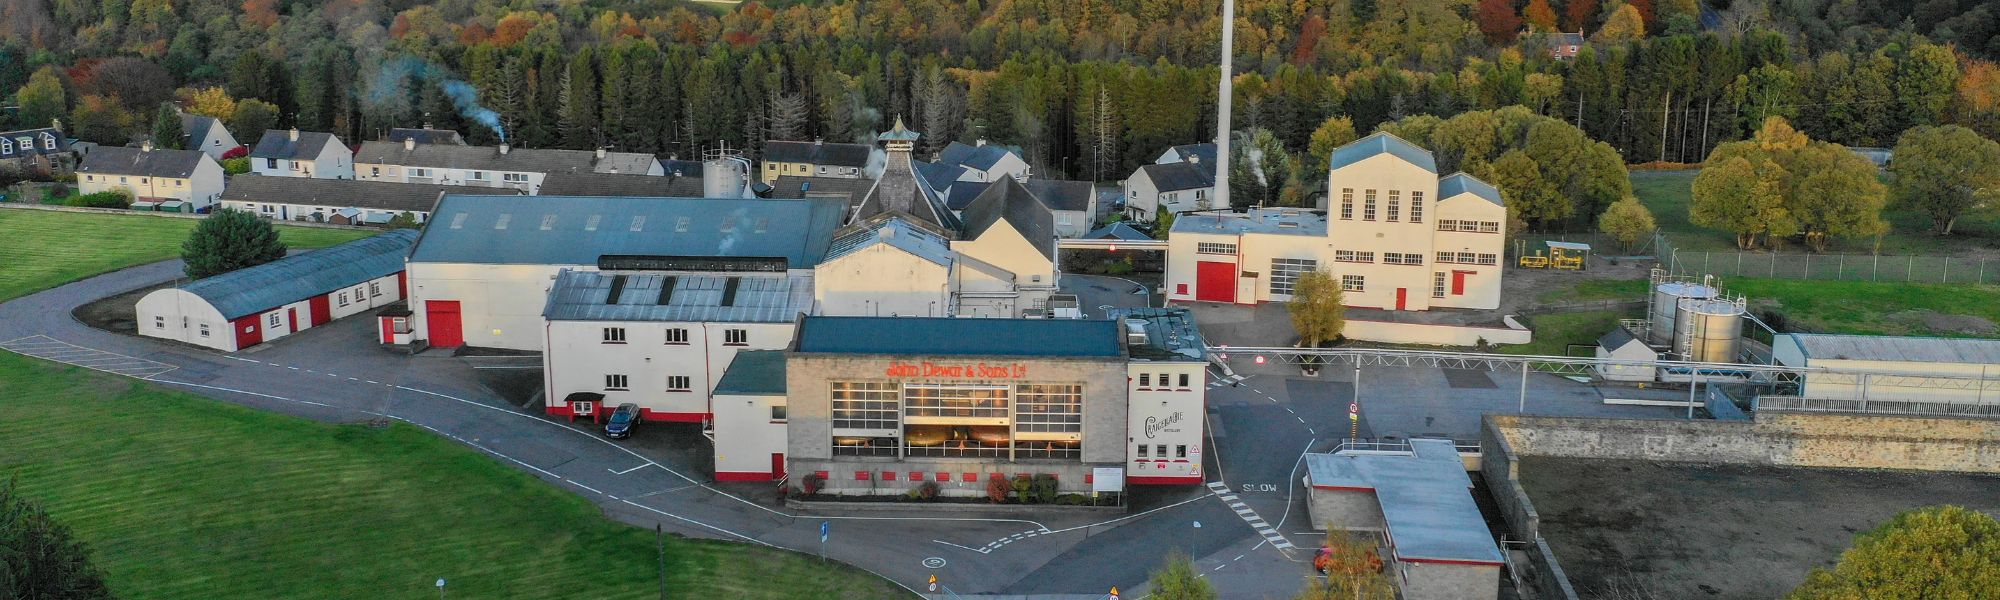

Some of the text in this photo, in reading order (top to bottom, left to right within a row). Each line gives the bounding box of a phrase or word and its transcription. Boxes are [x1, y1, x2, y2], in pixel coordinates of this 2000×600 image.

[886, 361, 919, 377] John
[922, 361, 963, 378] Dewar
[966, 364, 974, 378] &
[978, 362, 1008, 379] Sons
[1242, 483, 1277, 492] SLOW
